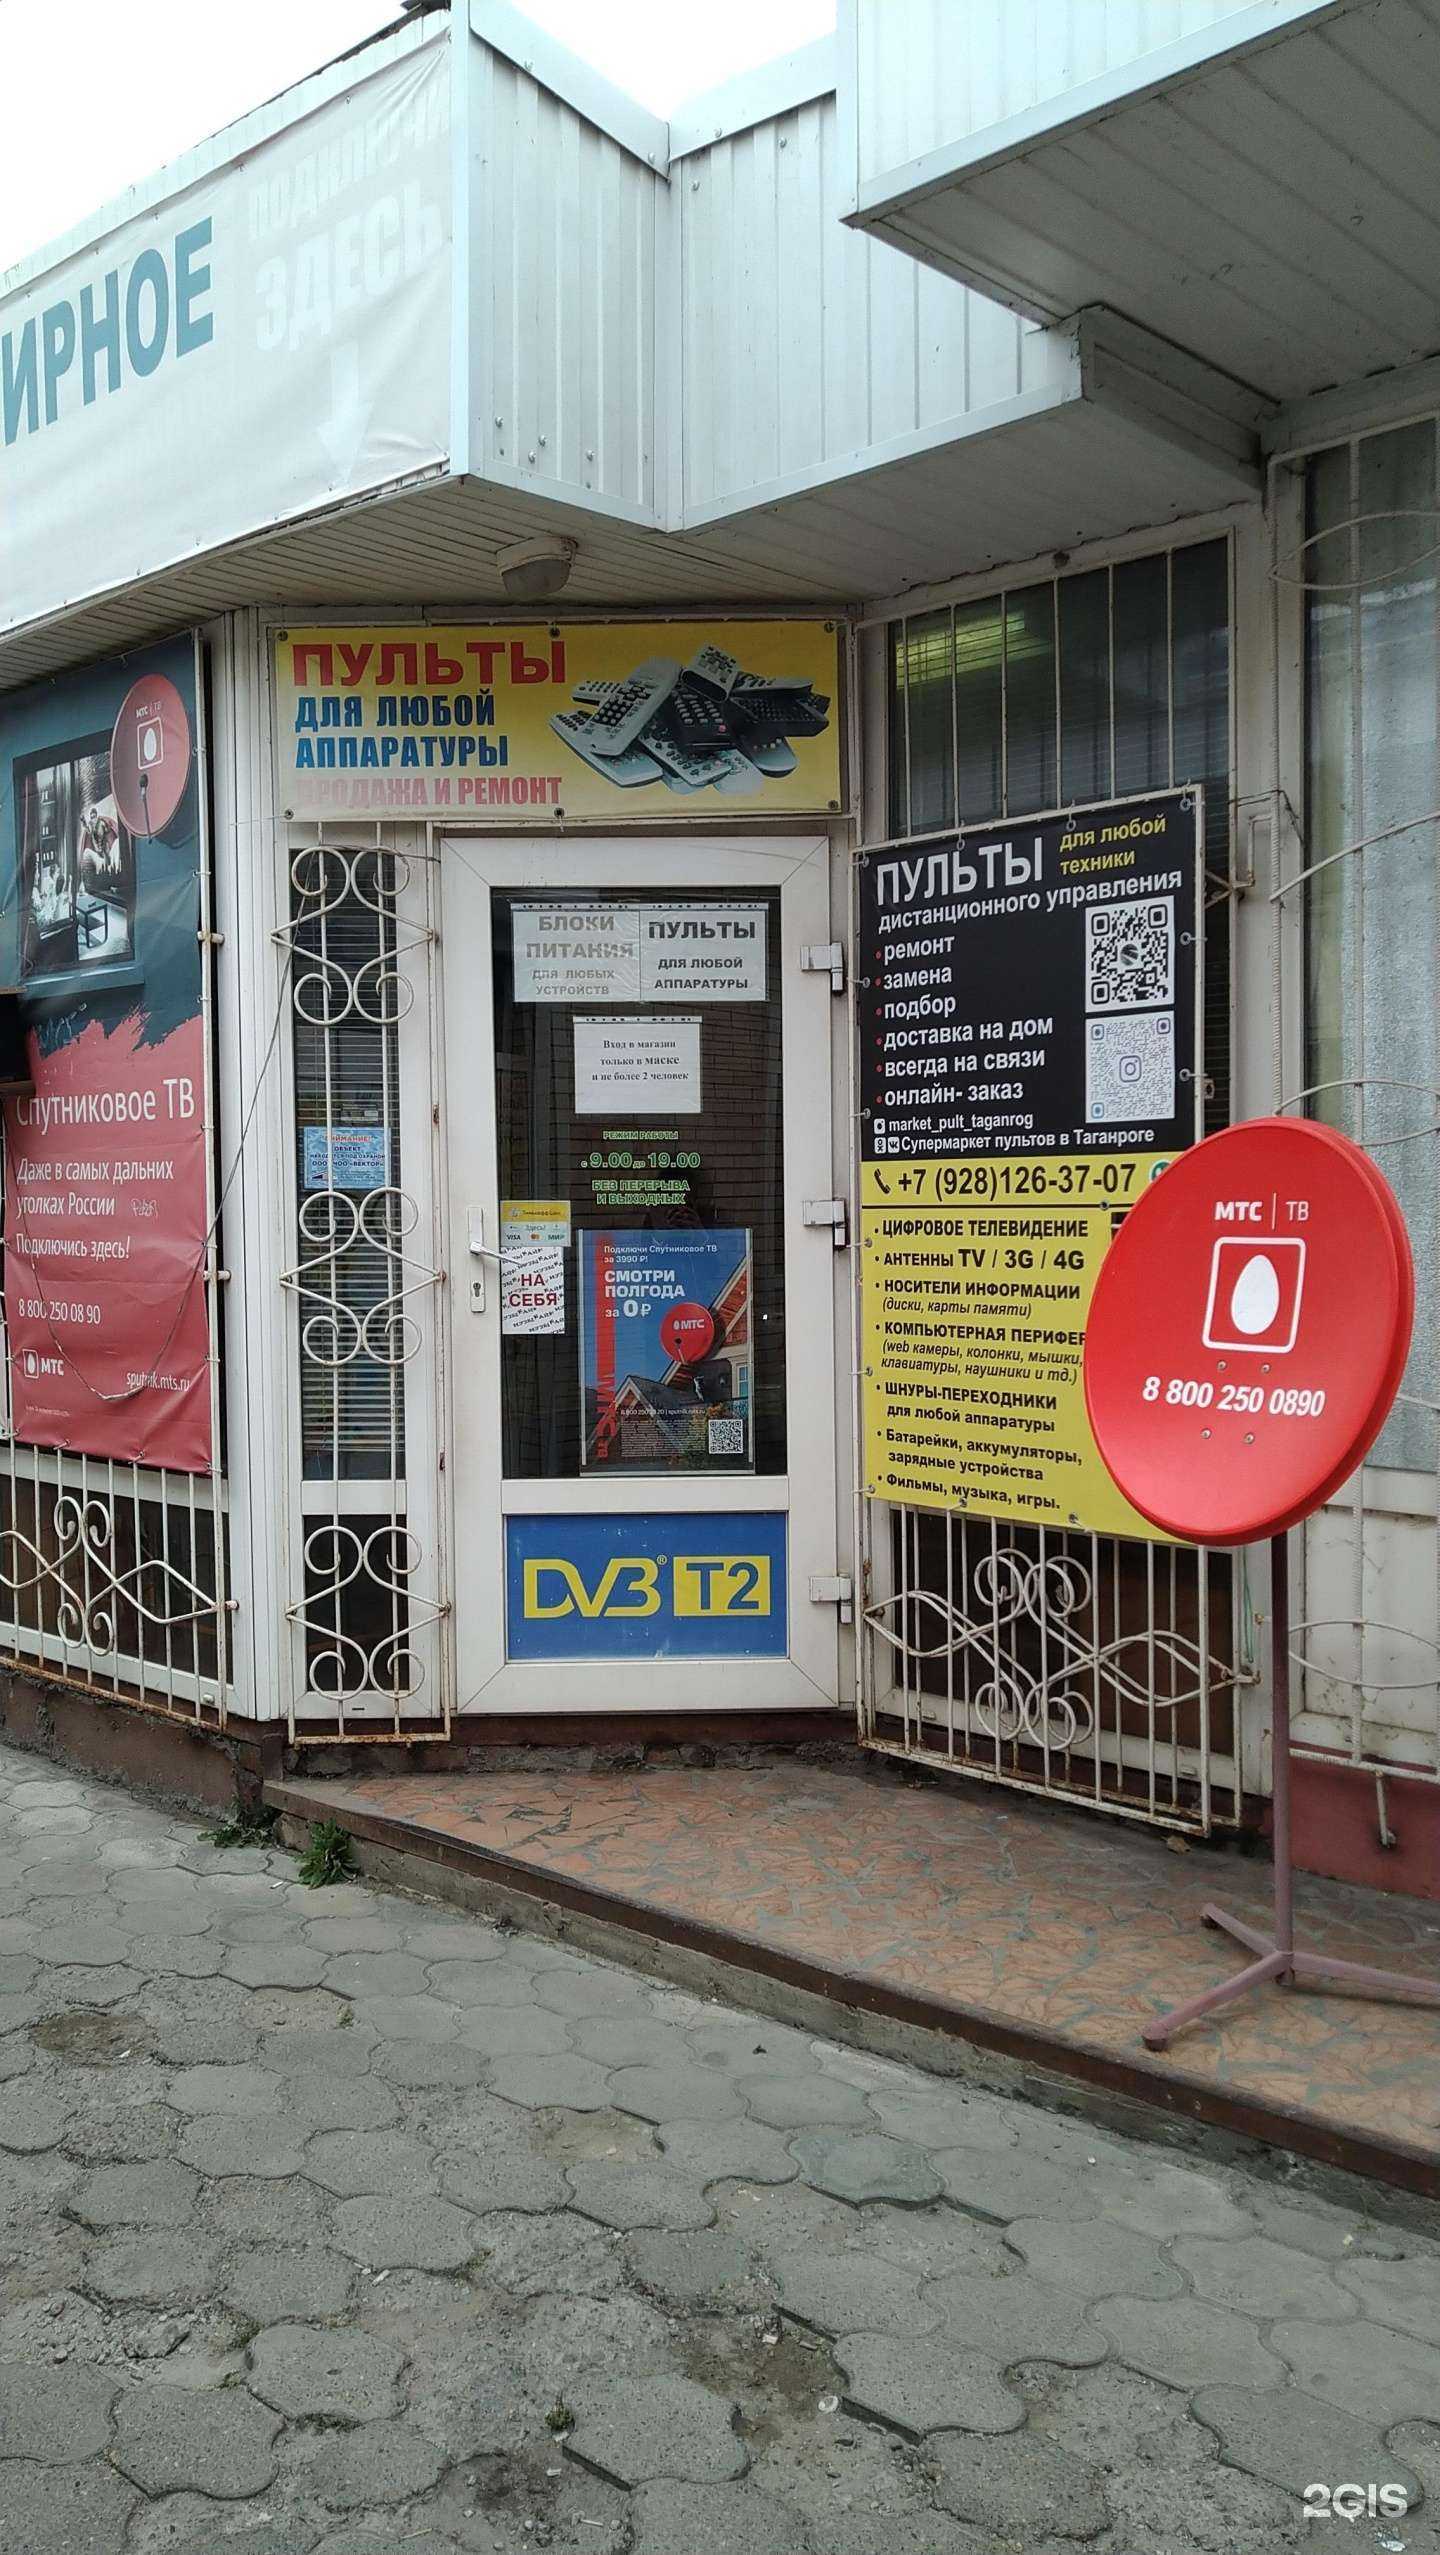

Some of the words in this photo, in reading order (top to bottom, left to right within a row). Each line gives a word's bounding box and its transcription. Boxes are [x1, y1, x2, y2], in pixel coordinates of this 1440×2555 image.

[254, 180, 443, 350] ЗДЕСЬ
[291, 641, 566, 687] ПУЛЬТЫ
[136, 705, 148, 719] МТС
[294, 696, 362, 732] ДЛЯ
[376, 688, 495, 727] ЛЮБОЙ
[295, 735, 509, 769] АППАРАТУРЫ
[297, 778, 427, 808] ПРОДАЖА
[434, 777, 451, 805] И
[458, 776, 563, 805] РЕМОНТ
[1059, 831, 1096, 853] для
[1100, 812, 1166, 845] любой
[876, 837, 1043, 906] ПУЛЬТЫ
[1060, 849, 1136, 876] техники
[878, 892, 1040, 934] дистанционного
[1046, 869, 1182, 913] управления
[539, 916, 615, 931] БЛОКИ
[649, 921, 756, 940] ПУЛЬТЫ
[526, 943, 633, 959] ПИТАНИЯ
[884, 934, 955, 966] ремонт
[532, 970, 559, 980] ДЛЯ
[566, 969, 615, 979] ЛЮБЫХ
[658, 959, 686, 970] ДЛЯ
[691, 957, 743, 969] ЛЮБОЙ
[535, 982, 609, 995] УСТРОЙСТВ
[655, 979, 748, 989] АППАРАТУРЫ
[884, 966, 953, 990] замена
[884, 992, 957, 1020] подбор
[603, 1040, 626, 1049] Вход
[637, 1041, 676, 1049] магазин
[884, 1024, 973, 1052] доставка
[979, 1021, 1003, 1040] на
[1009, 1016, 1053, 1040] дом
[645, 1056, 680, 1065] маске
[884, 1056, 948, 1079] всегда
[954, 1053, 978, 1071] на
[983, 1048, 1046, 1071] связи
[614, 1072, 641, 1081] более
[642, 1072, 648, 1080] 2
[650, 1073, 689, 1081] человек
[163, 1078, 195, 1120] ТВ
[884, 1084, 963, 1106] онлайн-
[967, 1082, 1024, 1101] заказ
[603, 1131, 638, 1139] РЕЖИМ
[640, 1131, 679, 1139] РАБОТЫ
[889, 1112, 1034, 1134] market_pult_taganrog
[901, 1136, 991, 1154] Супермаркет
[995, 1131, 1055, 1149] пультов
[1059, 1133, 1069, 1145] в
[1074, 1129, 1155, 1146] Таганроге
[16, 1158, 52, 1181] Даже
[55, 1164, 63, 1179] в
[66, 1161, 109, 1180] самых
[113, 1159, 174, 1184] дальних
[590, 1152, 632, 1168] 9.00
[648, 1152, 700, 1168] 19.00
[592, 1180, 617, 1191] БЕЗ
[620, 1180, 691, 1191] ПЕРЕРЫВА
[898, 1168, 927, 1195] +7
[934, 1163, 1137, 1202] (928)126-37-07
[16, 1196, 64, 1220] уголках
[69, 1191, 116, 1216] России
[597, 1194, 607, 1204] И
[609, 1193, 686, 1206] ВЫХОДНЫХ
[1215, 1201, 1263, 1222] МТС
[1285, 1200, 1309, 1222] ТВ
[882, 1219, 963, 1239] ЦИФРОВОЕ
[968, 1219, 1089, 1240] ТЕЛЕВИДЕНИЕ
[16, 1233, 88, 1258] Подключись
[90, 1235, 131, 1260] здесь!
[604, 1245, 648, 1254] Подключи
[649, 1245, 704, 1255] Спутниковое
[616, 1255, 638, 1263] 3990
[884, 1253, 954, 1267] АНТЕННЫ
[958, 1249, 985, 1268] TV
[991, 1249, 998, 1268] /
[1004, 1249, 1034, 1269] 3G
[1040, 1250, 1047, 1269] /
[1053, 1250, 1085, 1270] 4G
[521, 1274, 545, 1286] НА
[604, 1269, 675, 1283] СМОТРИ
[509, 1293, 557, 1306] СЕБЯ
[605, 1285, 685, 1299] ПОЛГОДА
[884, 1279, 961, 1295] НОСИТЕЛИ
[966, 1282, 1081, 1300] ИНФОРМАЦИИ
[18, 1298, 26, 1317] 8
[50, 1301, 68, 1322] 250
[70, 1303, 84, 1324] 08
[85, 1304, 101, 1325] 90
[605, 1307, 619, 1317] за
[623, 1300, 638, 1317] 0
[882, 1296, 924, 1314] (диски,
[928, 1302, 970, 1315] карты
[974, 1303, 1032, 1320] памяти)
[681, 1318, 705, 1329] МТС
[884, 1321, 1006, 1341] КОМПЬЮТЕРНАЯ
[882, 1338, 910, 1354] (web
[912, 1343, 963, 1359] камеры,
[966, 1348, 1024, 1363] колонки,
[1028, 1352, 1083, 1367] мышки,
[41, 1358, 65, 1376] МТС
[881, 1356, 961, 1376] клавиатуры,
[965, 1366, 1031, 1379] наушники
[1035, 1370, 1043, 1379] и
[1047, 1368, 1078, 1386] тд.)
[885, 1381, 1057, 1410] ШНУРЫ-ПЕРЕХОДНИКИ
[1142, 1376, 1160, 1402] 8
[1165, 1378, 1214, 1408] 800
[1217, 1383, 1264, 1413] 250
[1269, 1388, 1326, 1417] 0890
[887, 1405, 911, 1418] для
[915, 1406, 960, 1422] любой
[965, 1414, 1055, 1434] аппаратуры
[886, 1428, 963, 1452] Батарейки,
[967, 1440, 1082, 1466] аккумуляторы,
[888, 1452, 956, 1468] зарядные
[960, 1459, 1044, 1481] устройства
[886, 1473, 948, 1496] Фильмы,
[952, 1483, 1012, 1505] музыка,
[1017, 1494, 1061, 1511] игры.
[686, 1562, 760, 1610] T2
